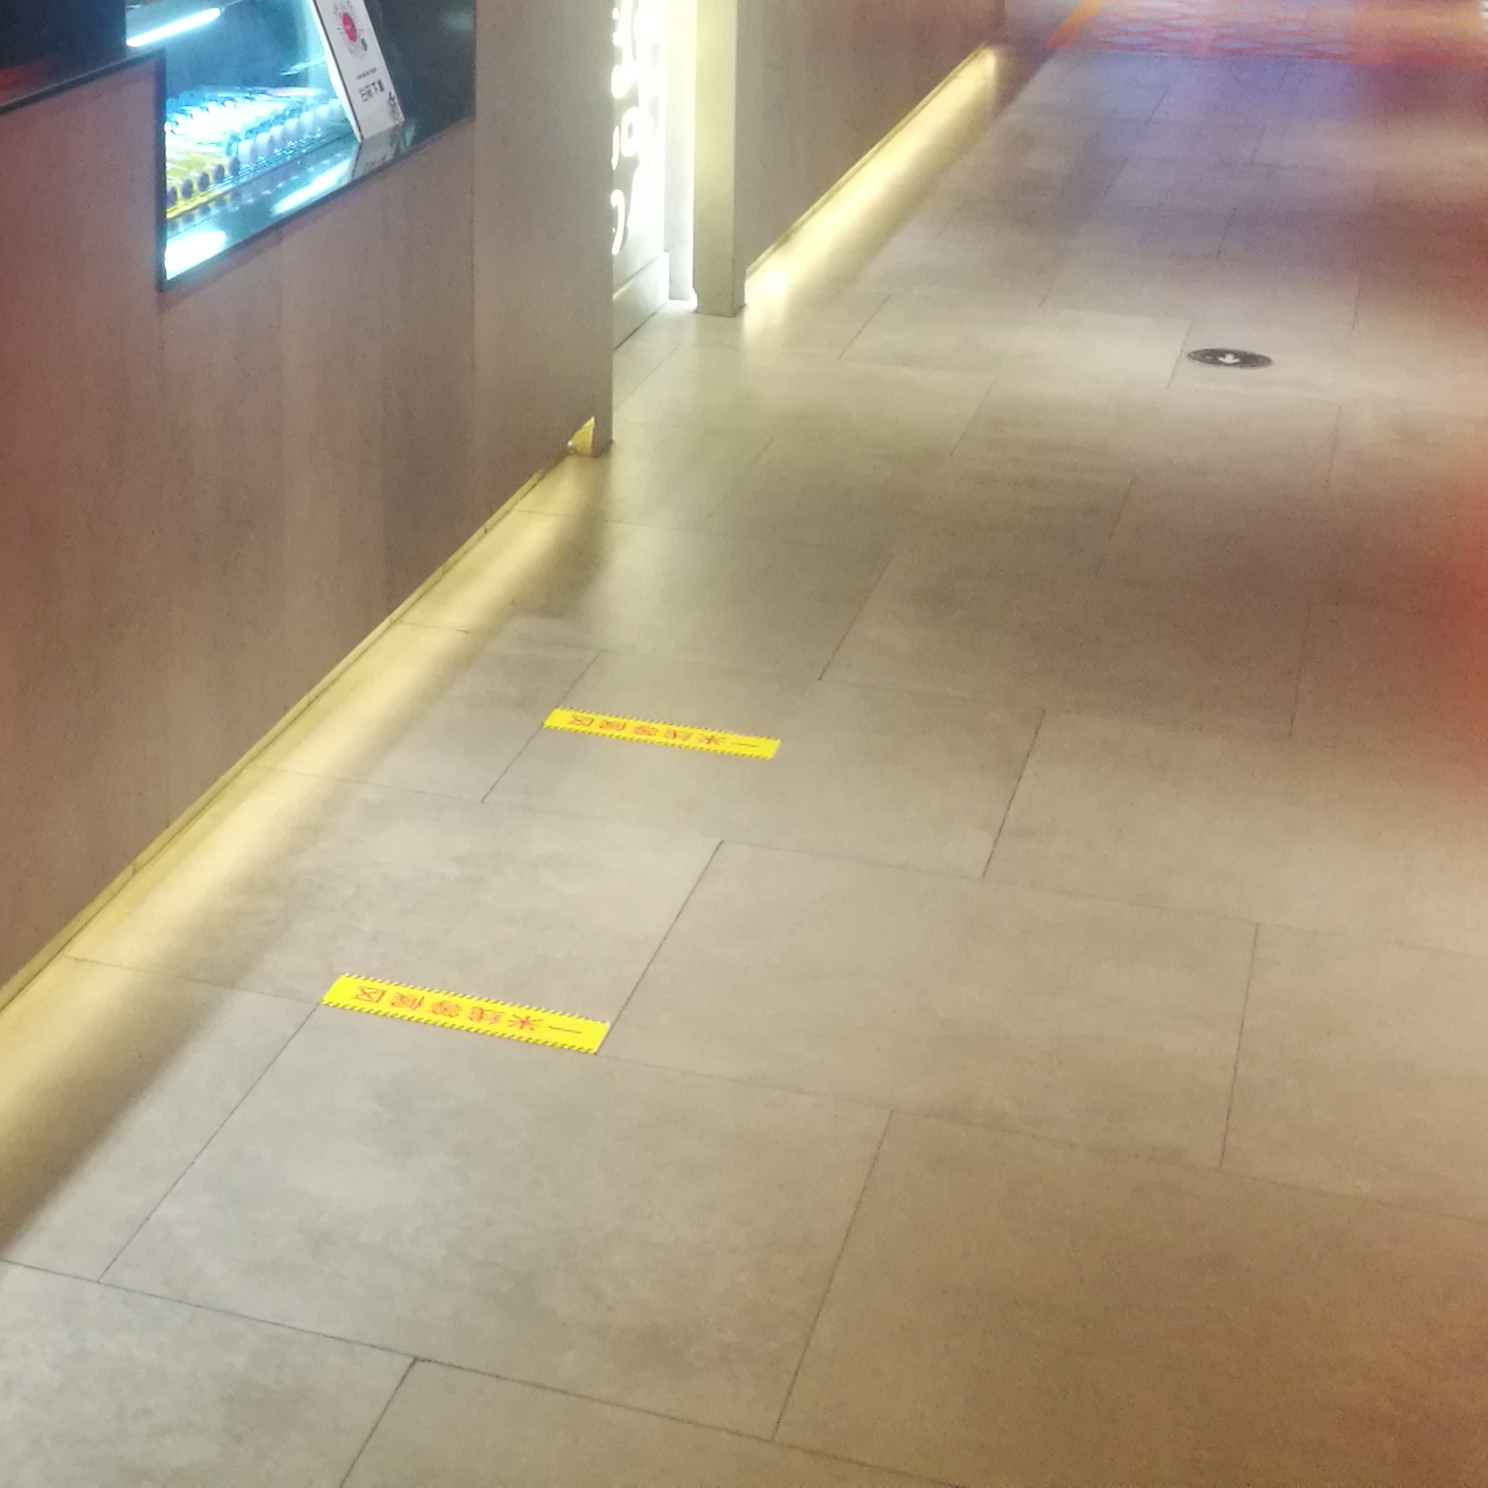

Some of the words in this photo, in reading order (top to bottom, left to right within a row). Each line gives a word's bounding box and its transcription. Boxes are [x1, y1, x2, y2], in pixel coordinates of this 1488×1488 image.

[351, 985, 583, 1035] 一米线等候区
